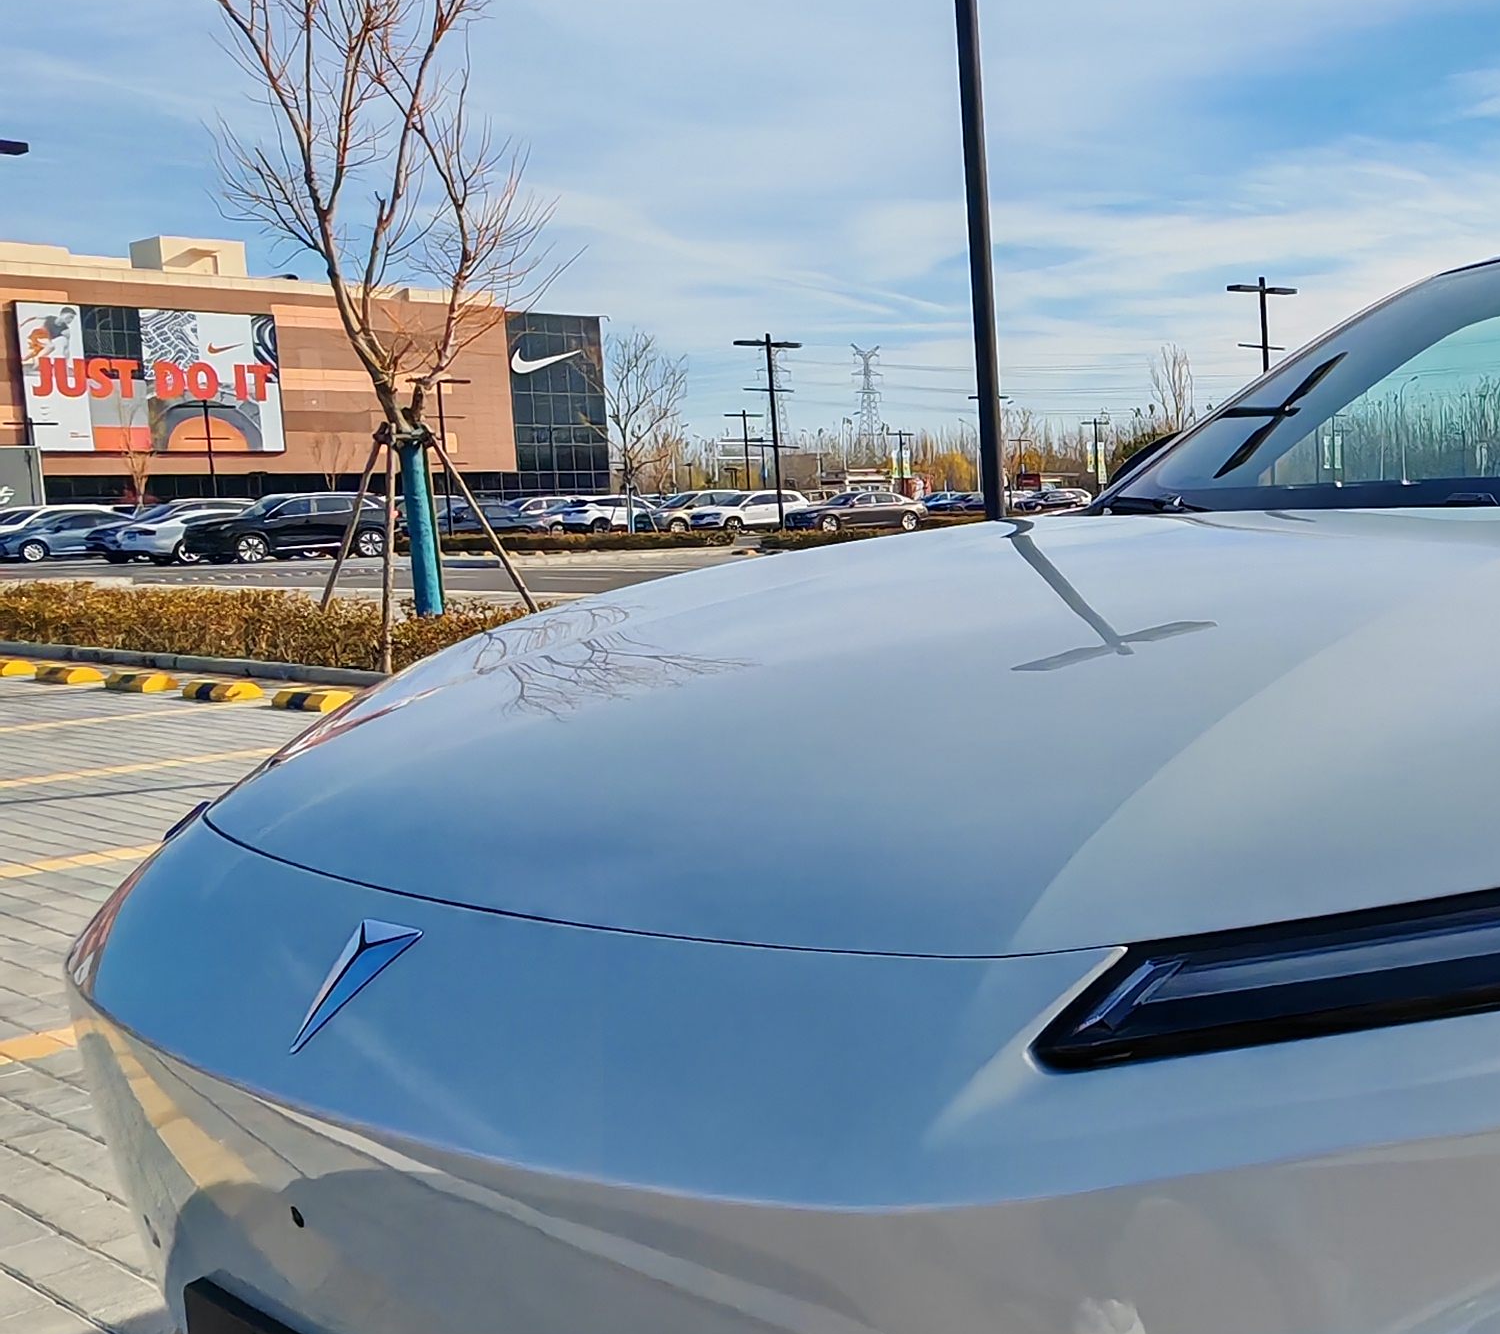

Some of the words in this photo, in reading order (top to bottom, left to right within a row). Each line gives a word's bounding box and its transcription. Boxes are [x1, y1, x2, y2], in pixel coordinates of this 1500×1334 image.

[33, 358, 139, 398] JUST
[155, 361, 219, 400] DO
[235, 364, 272, 401] IT
